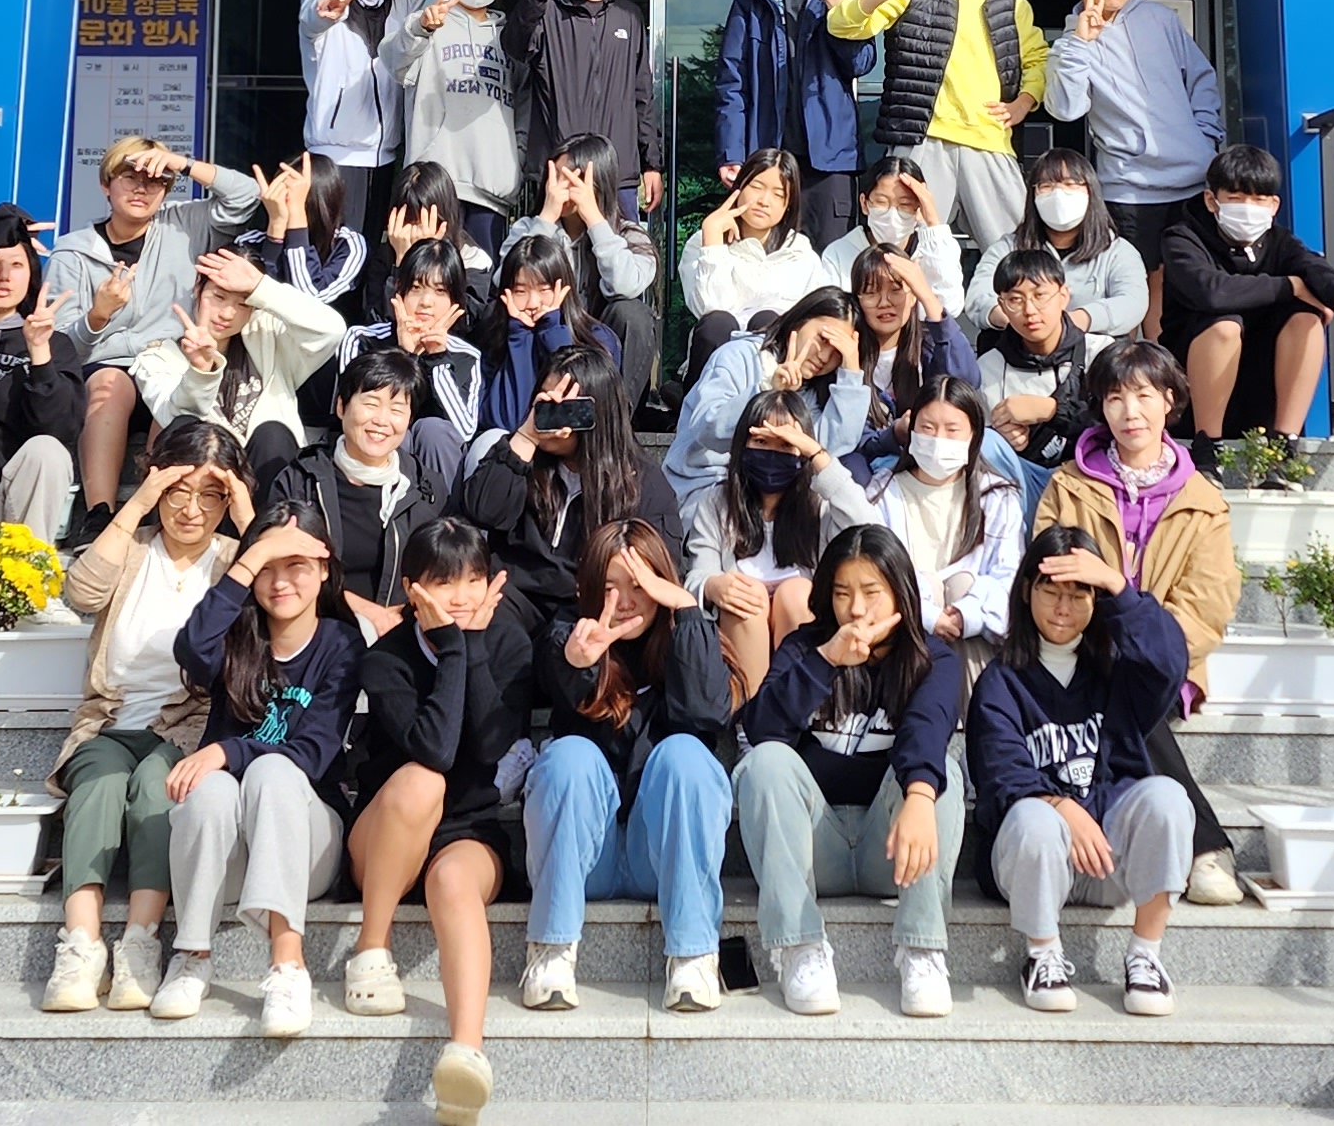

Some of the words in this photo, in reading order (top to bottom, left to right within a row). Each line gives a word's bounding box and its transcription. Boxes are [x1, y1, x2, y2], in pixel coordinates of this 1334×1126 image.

[79, 19, 136, 46] 문화
[142, 20, 199, 46] 행사
[446, 79, 480, 94] NEW
[1026, 722, 1068, 770] NEW
